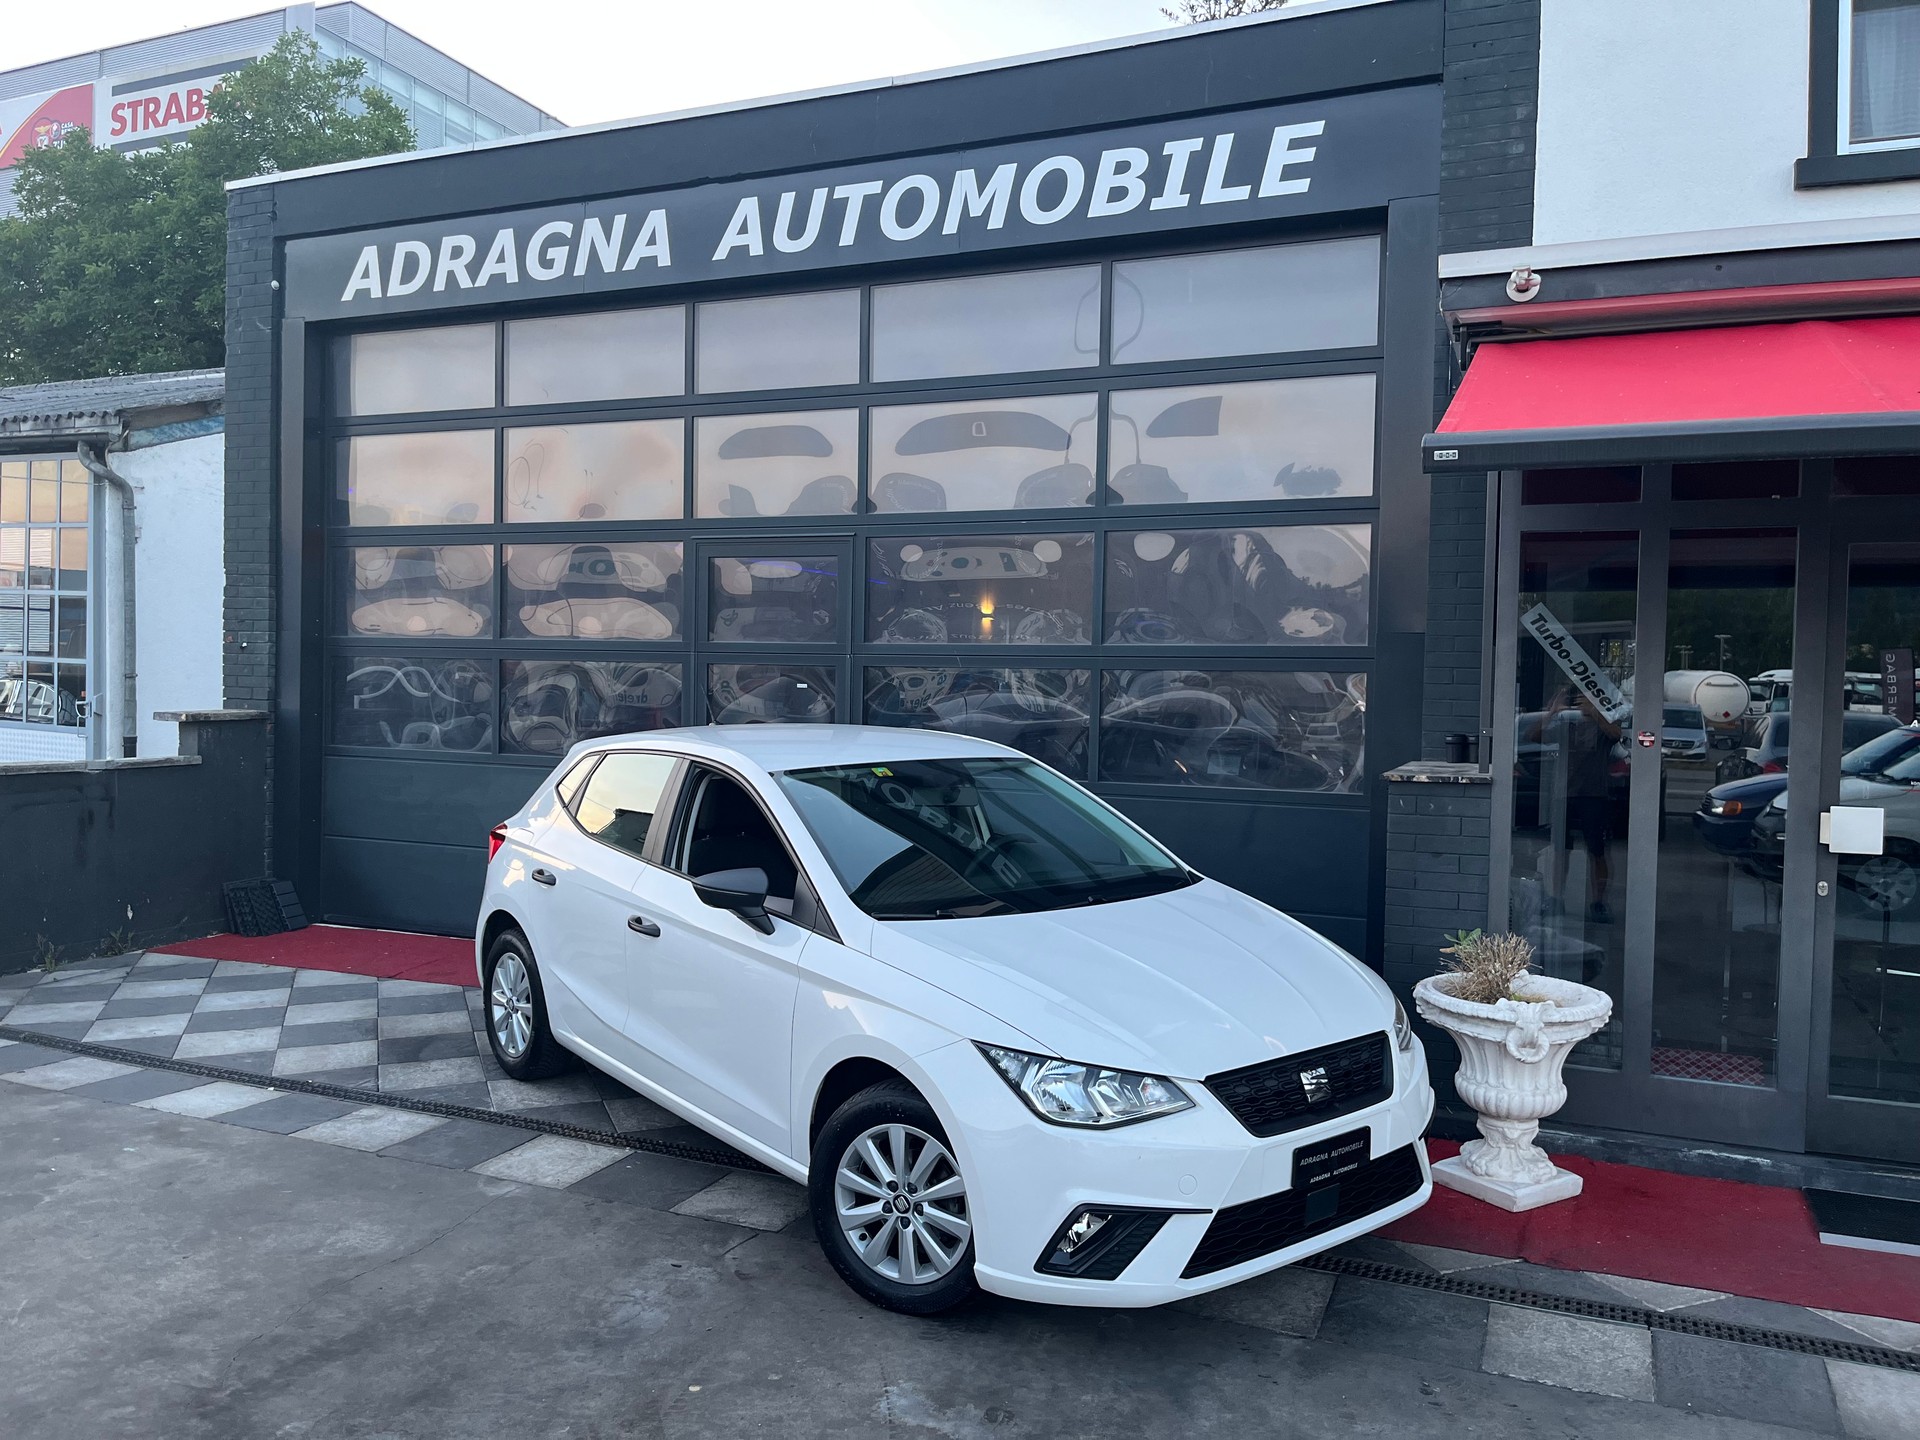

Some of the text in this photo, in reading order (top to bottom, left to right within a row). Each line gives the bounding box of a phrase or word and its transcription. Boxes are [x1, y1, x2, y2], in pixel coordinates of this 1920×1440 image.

[341, 119, 1326, 302] ADRAGNA AUTOMOBILE
[1530, 612, 1624, 713] Turbo-Diesel
[1299, 1140, 1364, 1167] ADRAGNA AUTOMOBILE
